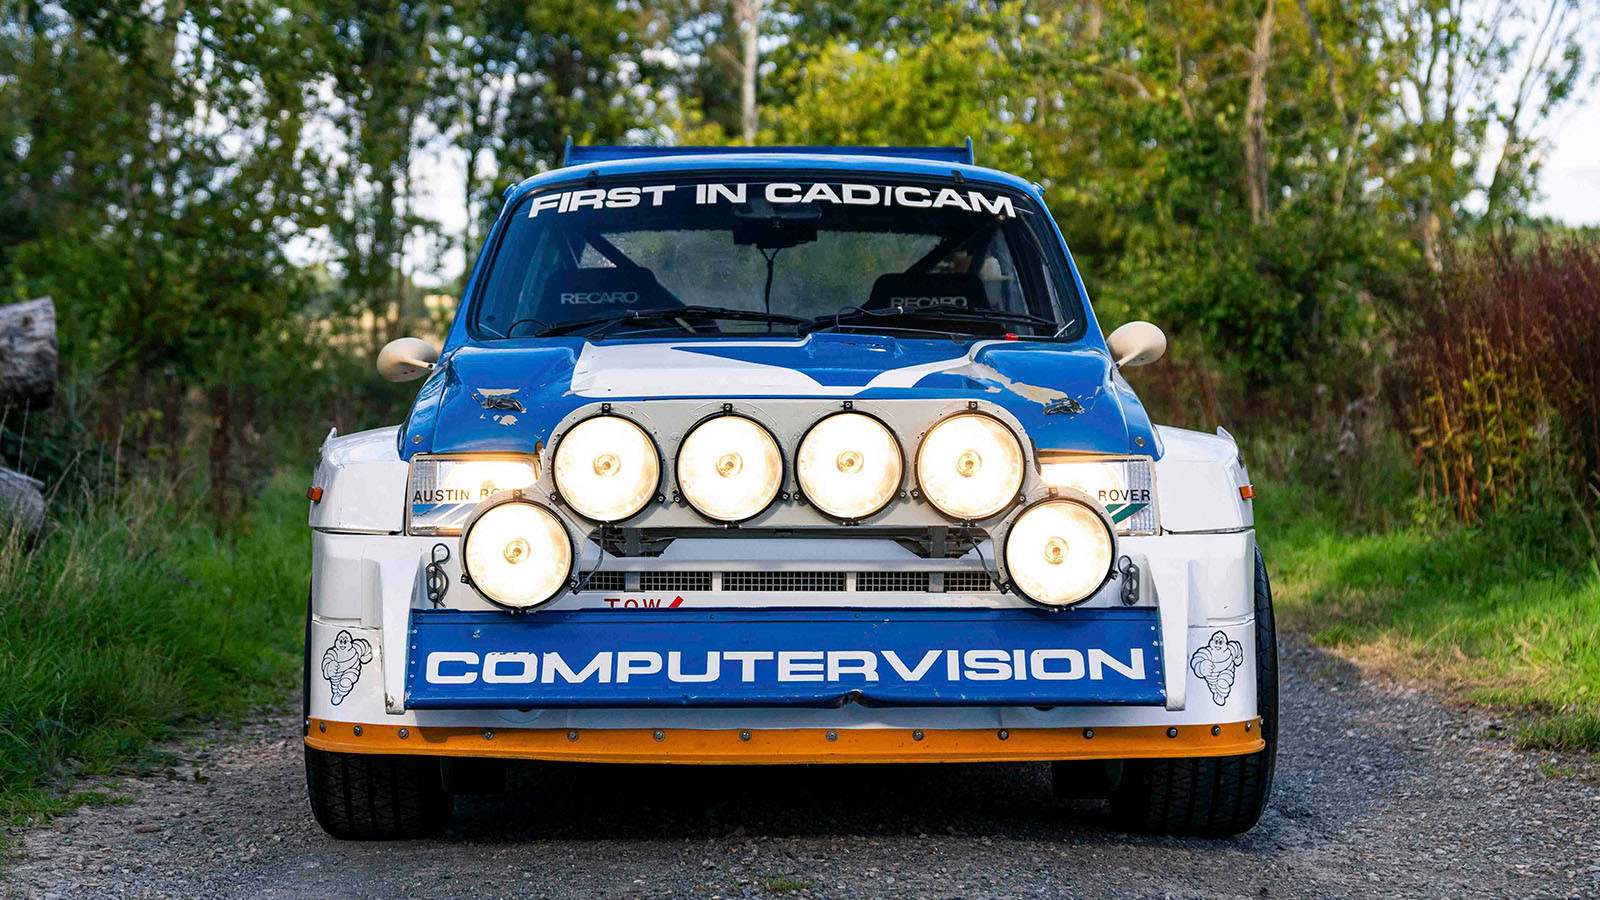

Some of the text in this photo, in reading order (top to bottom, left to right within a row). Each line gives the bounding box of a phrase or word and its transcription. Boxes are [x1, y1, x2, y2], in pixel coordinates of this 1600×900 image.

[528, 182, 1017, 219] FIRST IN CAD/CAM
[560, 291, 639, 305] RECARO
[412, 489, 470, 503] AUSTIN
[1098, 489, 1151, 502] ROVER
[425, 647, 1147, 685] COMPUTERVISION
